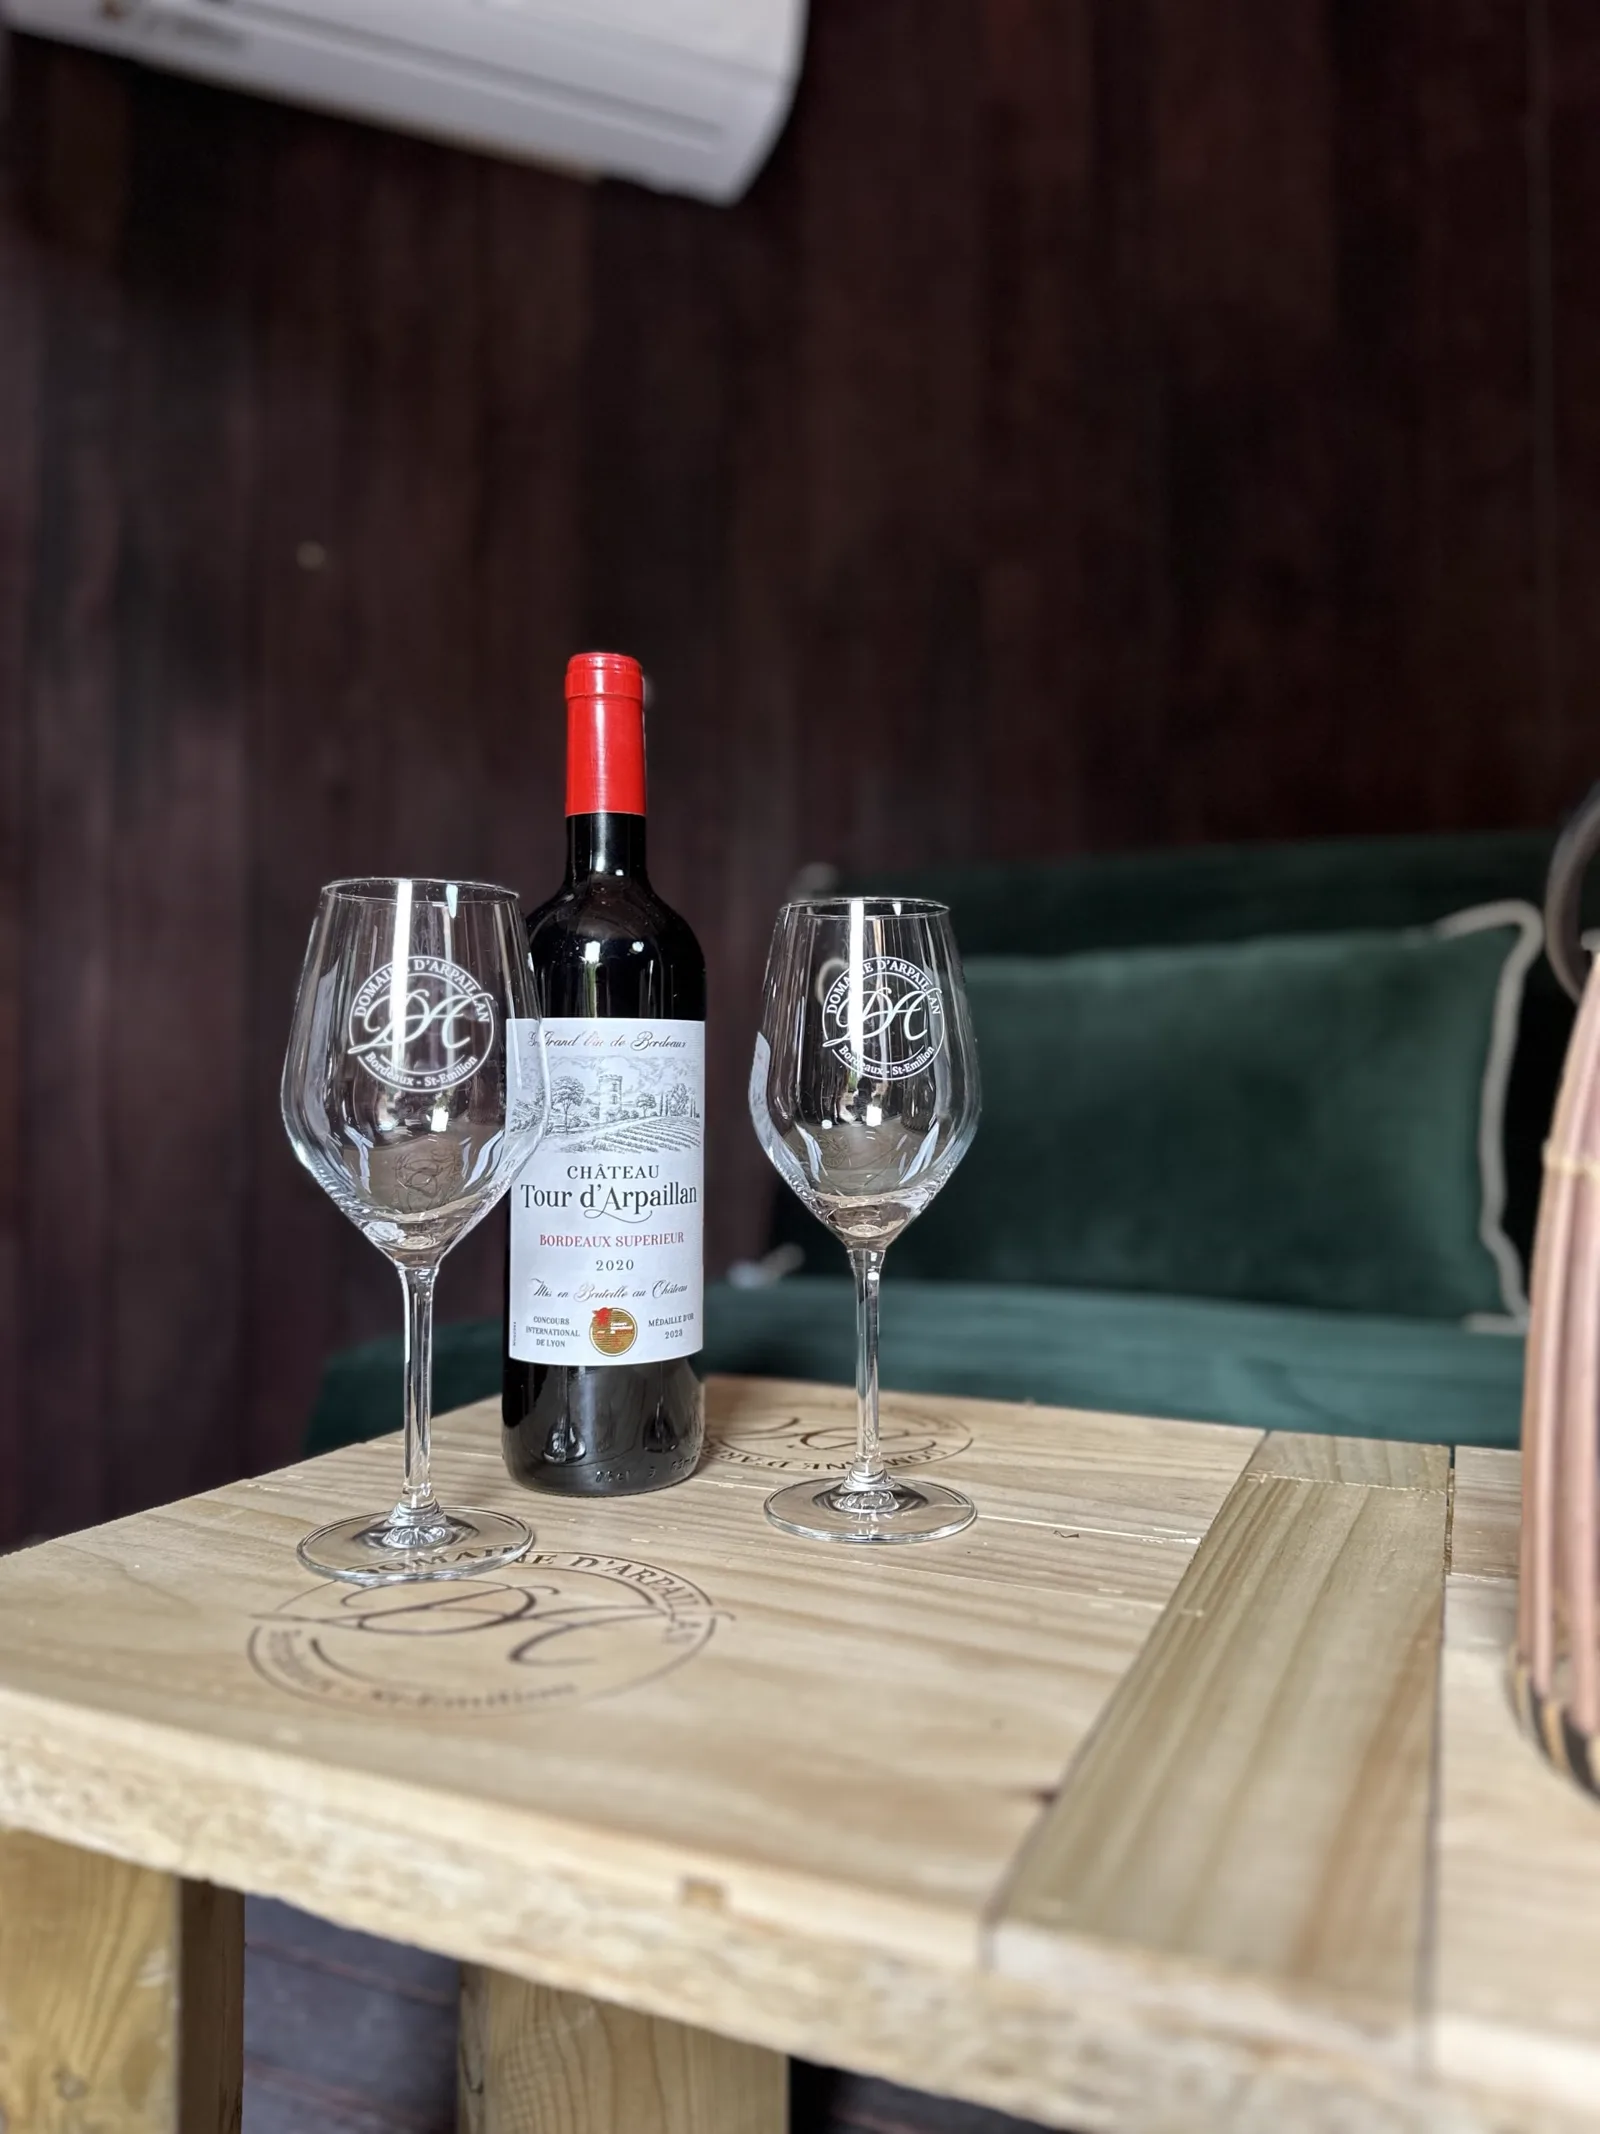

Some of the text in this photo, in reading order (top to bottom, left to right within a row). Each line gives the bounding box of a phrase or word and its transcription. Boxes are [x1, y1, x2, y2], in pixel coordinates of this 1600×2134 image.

[354, 961, 410, 1017] DOMAI
[827, 961, 874, 1014] DOMAE
[540, 1030, 581, 1047] Grand
[609, 1034, 626, 1047] de
[630, 1031, 687, 1051] Bordeaux
[365, 1051, 414, 1086] Bordeaux
[424, 1056, 478, 1087] St-Emilion
[893, 1046, 935, 1075] St-Emilion
[567, 1164, 660, 1180] CHÂTEAU
[520, 1182, 698, 1223] Tour d'Arpaillan
[540, 1232, 685, 1248] BORDEAUX SUPERIEUR
[596, 1259, 634, 1271] 2020
[531, 1278, 552, 1297] Mis
[574, 1281, 628, 1302] Bouteille
[632, 1290, 647, 1298] au
[652, 1279, 688, 1299] Château
[533, 1316, 570, 1325] CONCOURS
[648, 1315, 682, 1327] MÉDAILLE
[526, 1326, 581, 1337] INTERNATIONAL
[536, 1339, 565, 1348] DE LYON
[802, 1449, 946, 1470] DOMNE
